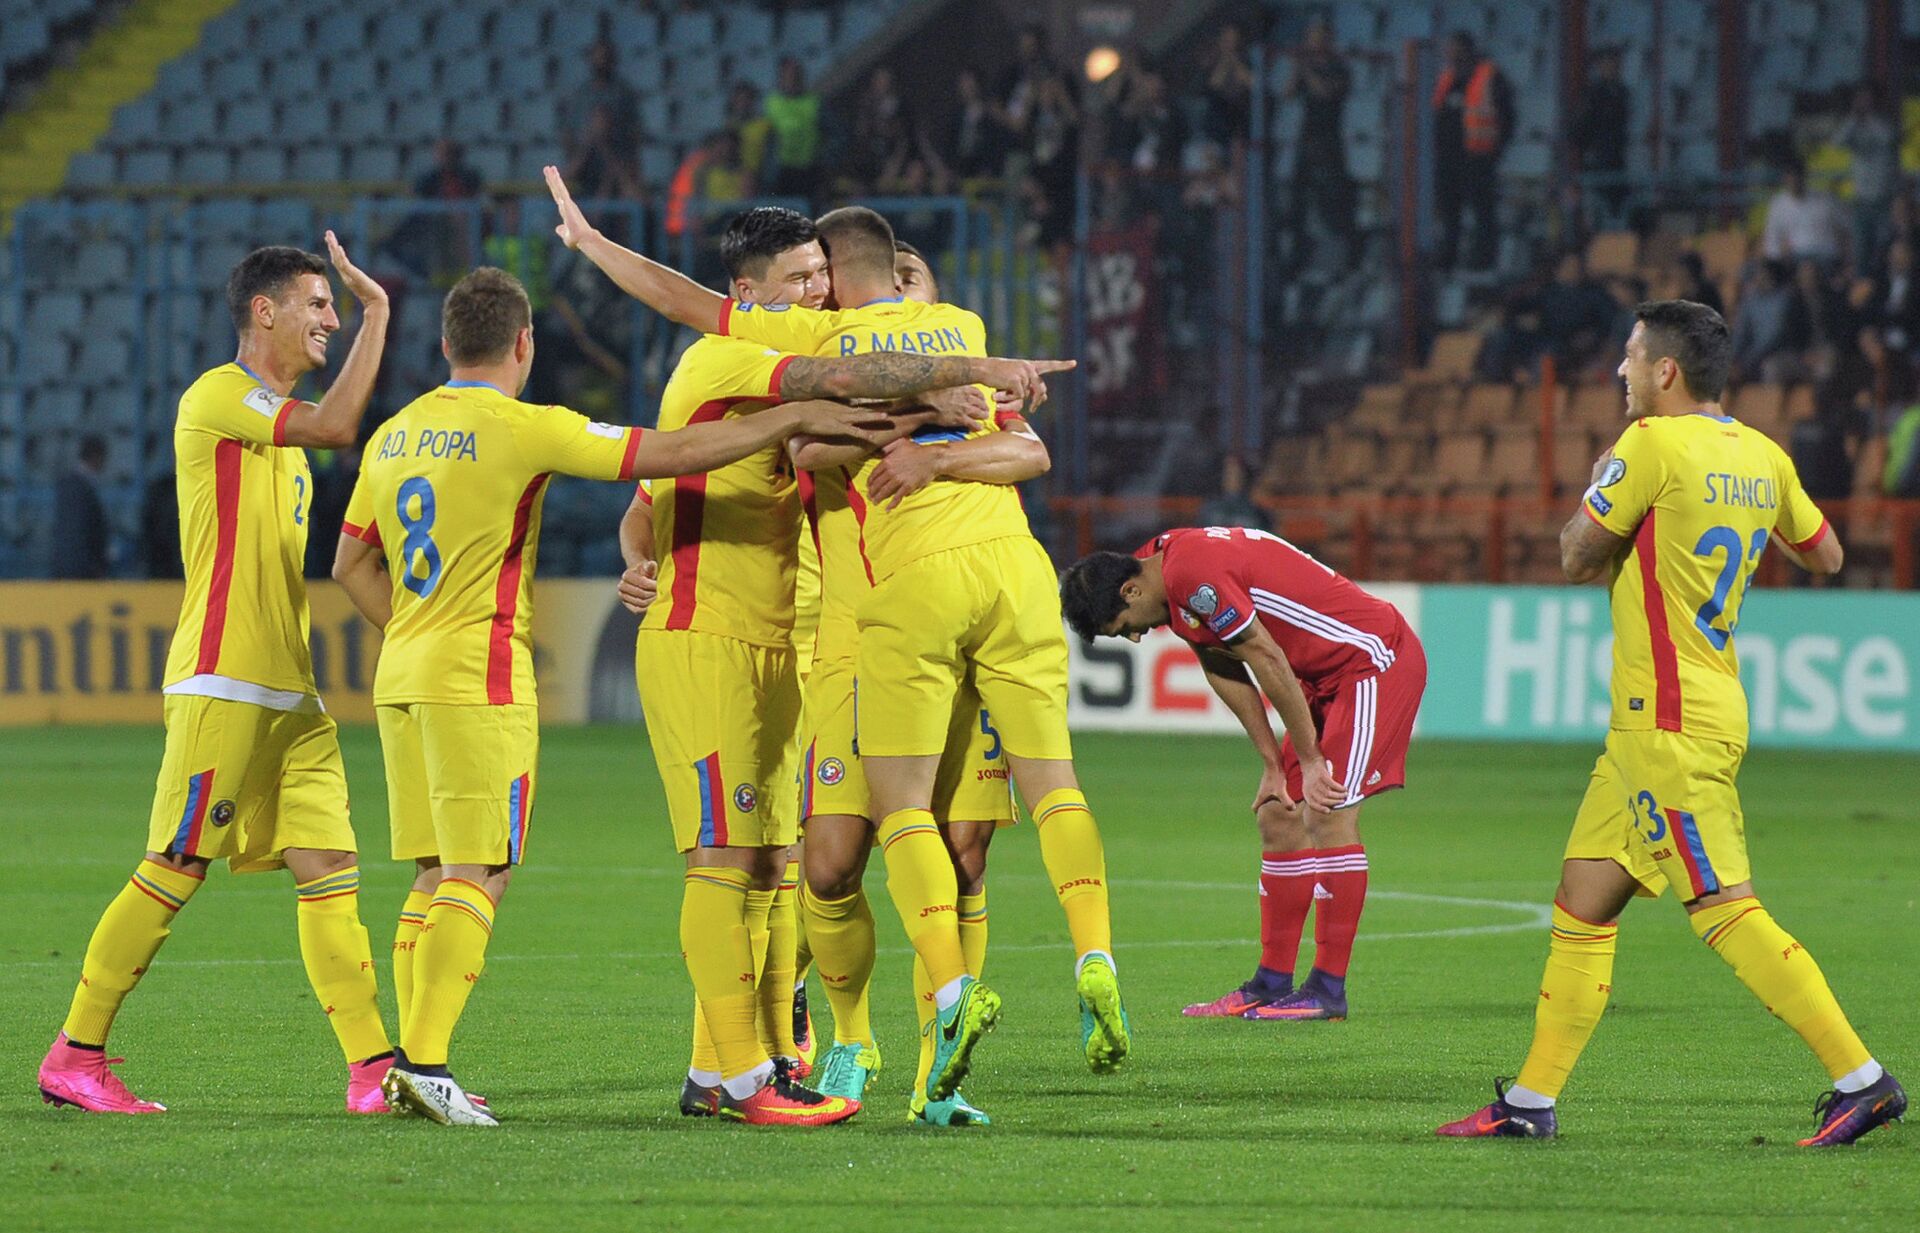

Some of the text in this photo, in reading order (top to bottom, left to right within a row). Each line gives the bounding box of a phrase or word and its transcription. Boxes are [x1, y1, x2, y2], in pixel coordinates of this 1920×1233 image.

[871, 327, 968, 353] MARIN
[377, 429, 477, 462] AD. POPA
[294, 475, 305, 526] 2
[1704, 472, 1776, 509] STANCIU
[396, 476, 443, 599] 8
[1482, 597, 1910, 737] Hinse
[980, 709, 1001, 760] 5
